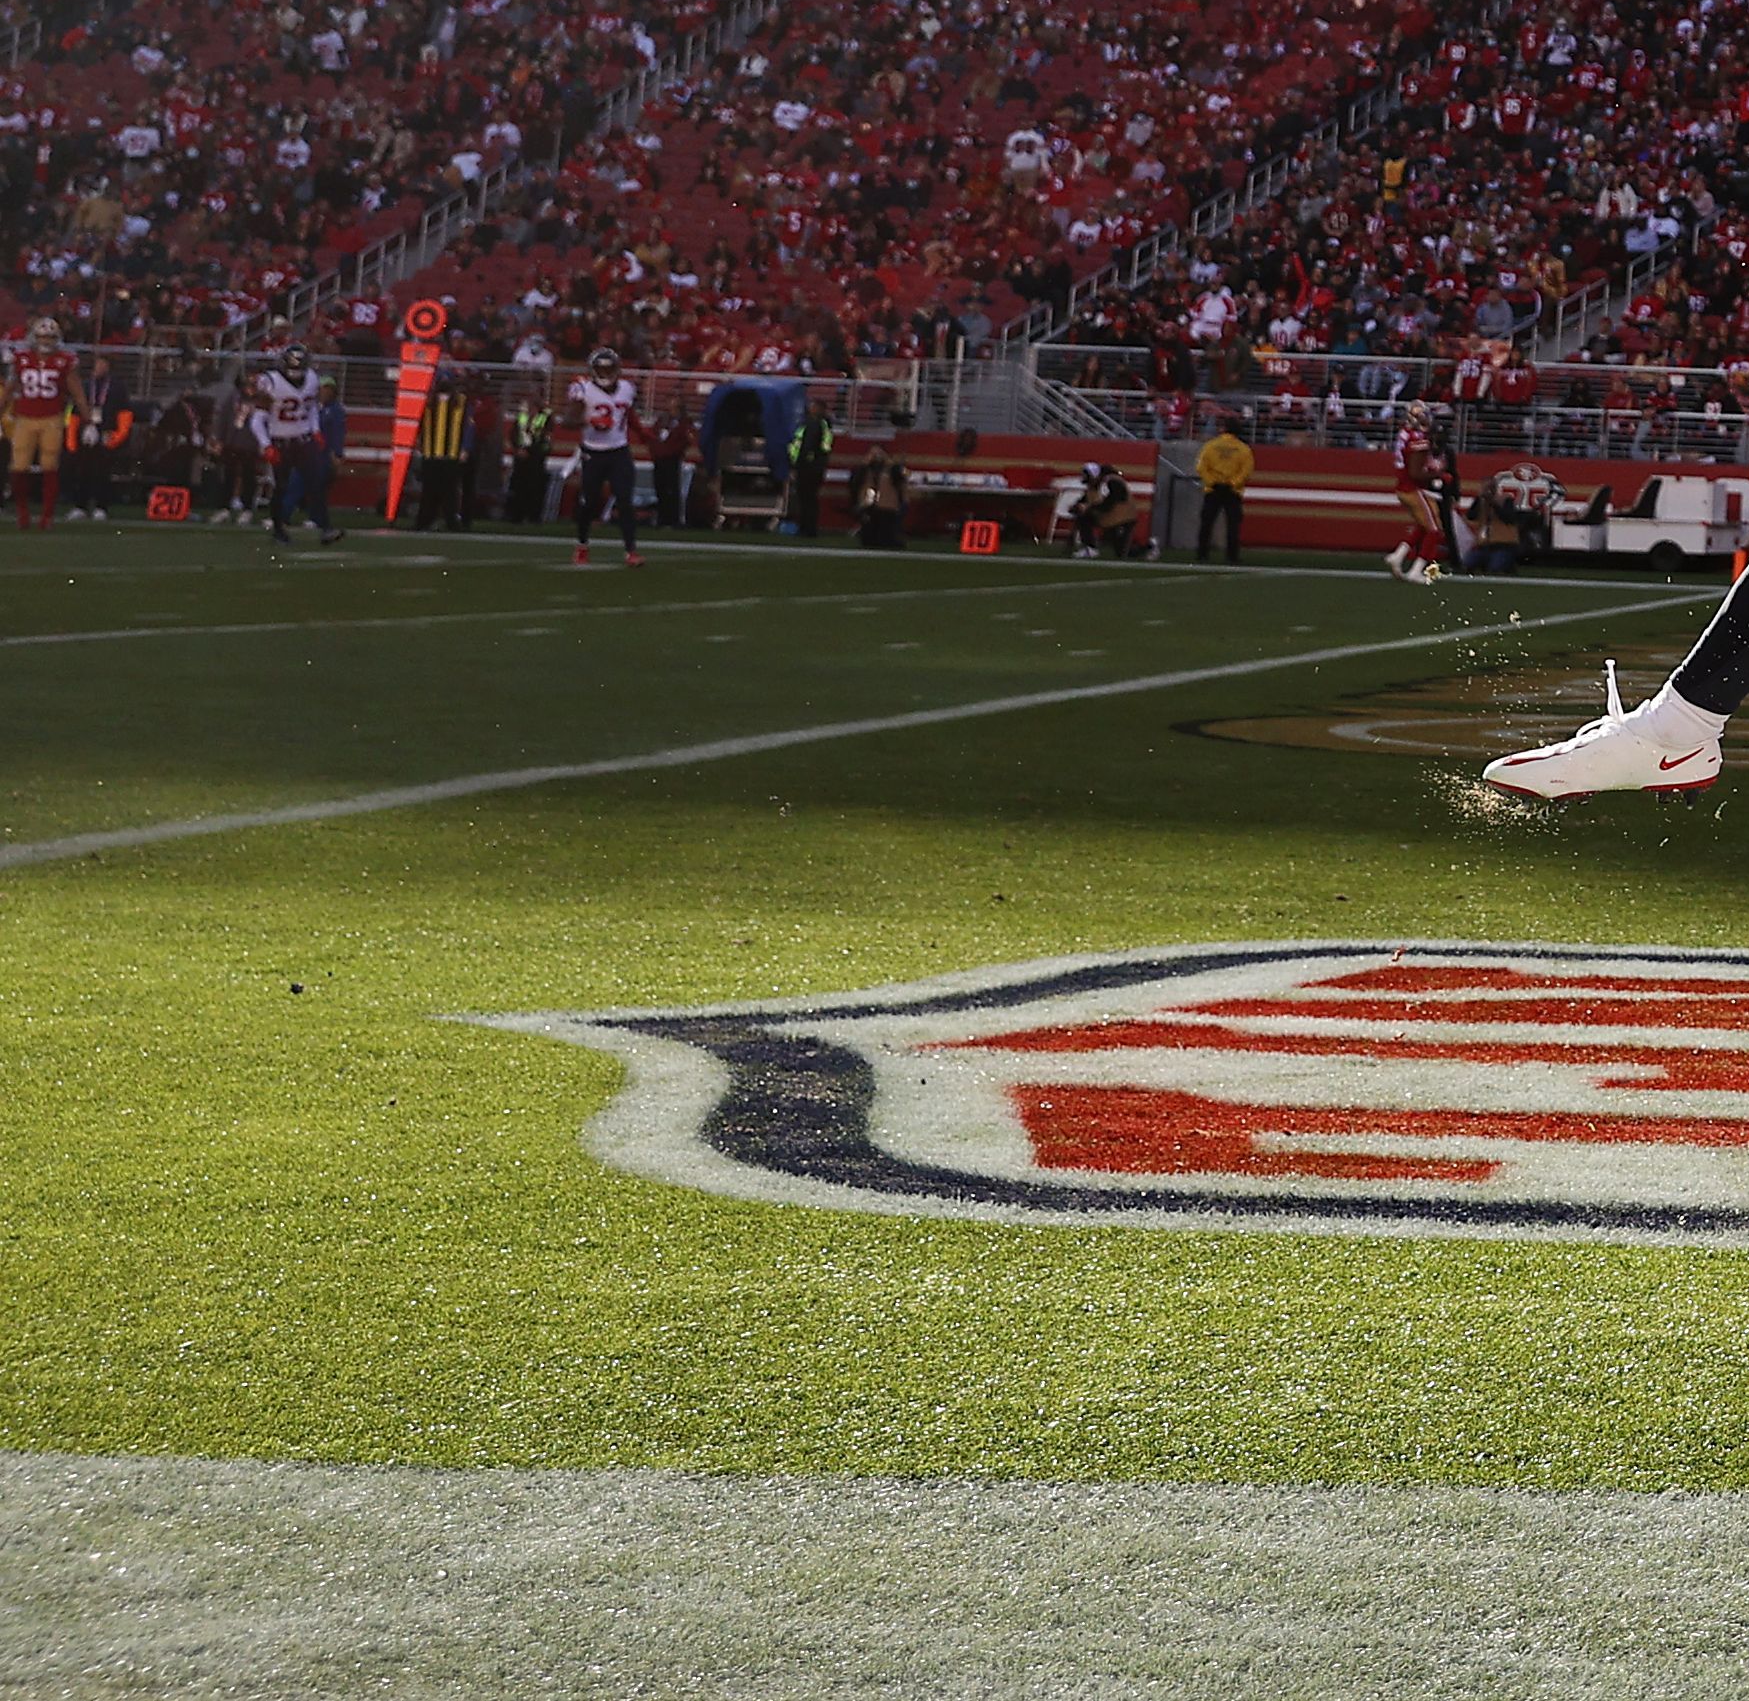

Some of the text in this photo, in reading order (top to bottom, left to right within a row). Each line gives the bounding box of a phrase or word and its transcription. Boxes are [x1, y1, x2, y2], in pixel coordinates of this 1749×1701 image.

[20, 368, 59, 399] 85
[153, 492, 184, 513] 20
[967, 525, 991, 549] 10
